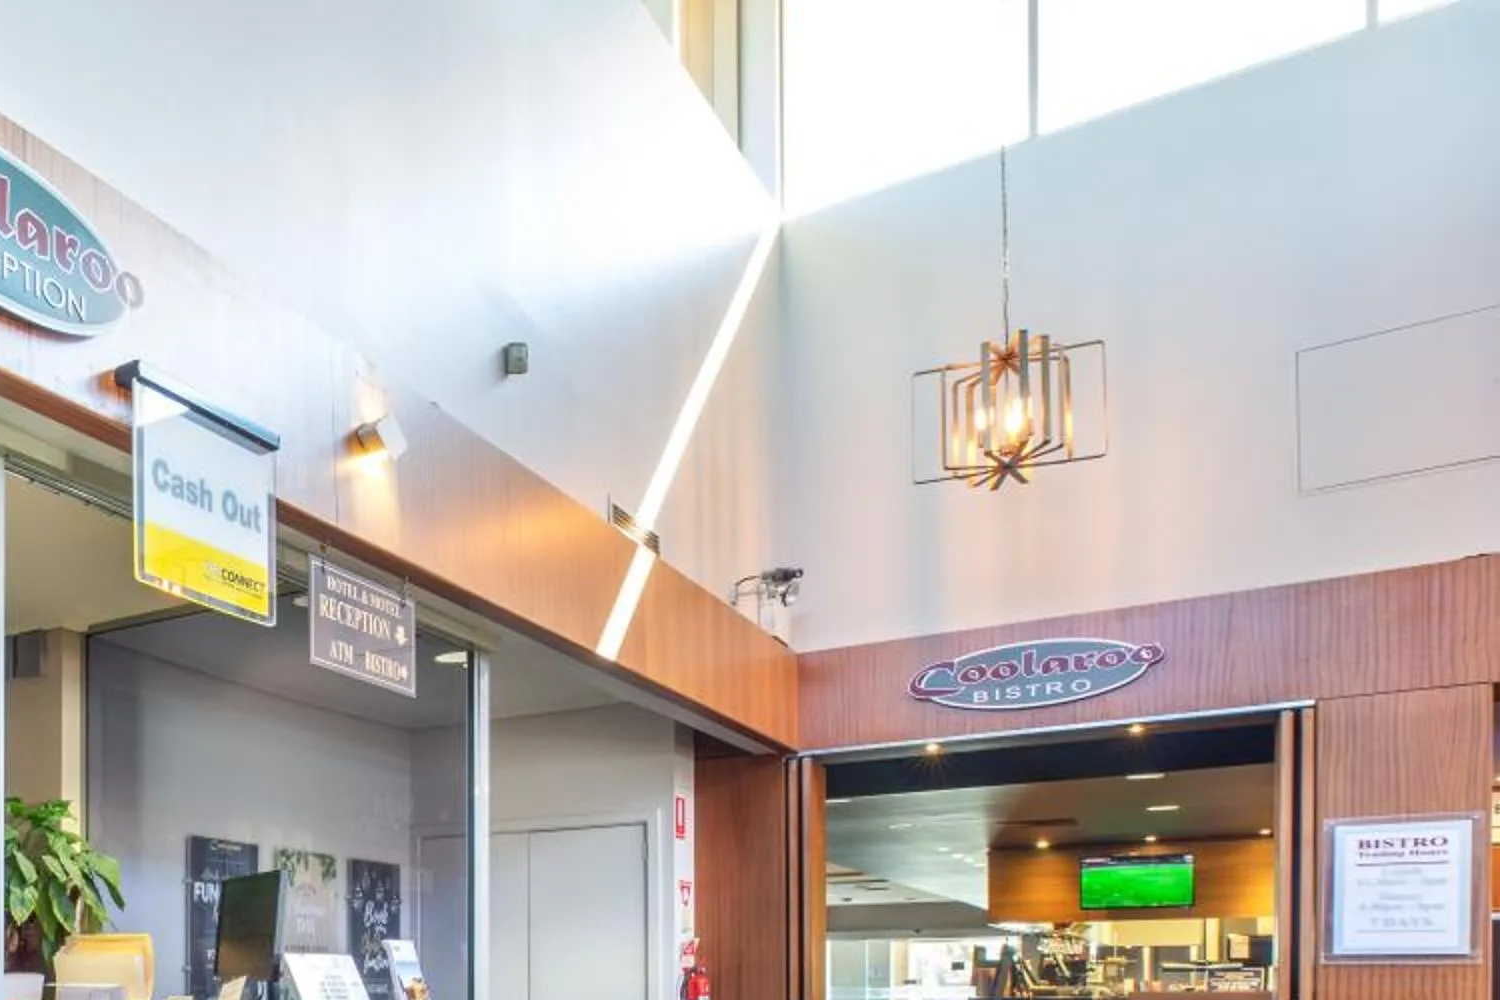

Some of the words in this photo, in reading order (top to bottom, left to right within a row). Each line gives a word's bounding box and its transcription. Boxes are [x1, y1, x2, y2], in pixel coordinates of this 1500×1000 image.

[151, 457, 214, 513] Cash
[221, 488, 262, 534] Out
[319, 593, 392, 641] RECEPTION
[326, 575, 358, 601] HOTEL
[370, 593, 401, 619] MOTEL
[329, 639, 354, 665] ATM
[364, 649, 402, 681] BISTRO
[908, 642, 1165, 700] Coolaroo
[972, 679, 1092, 703] BISTRO
[1357, 835, 1449, 850] BISTRO
